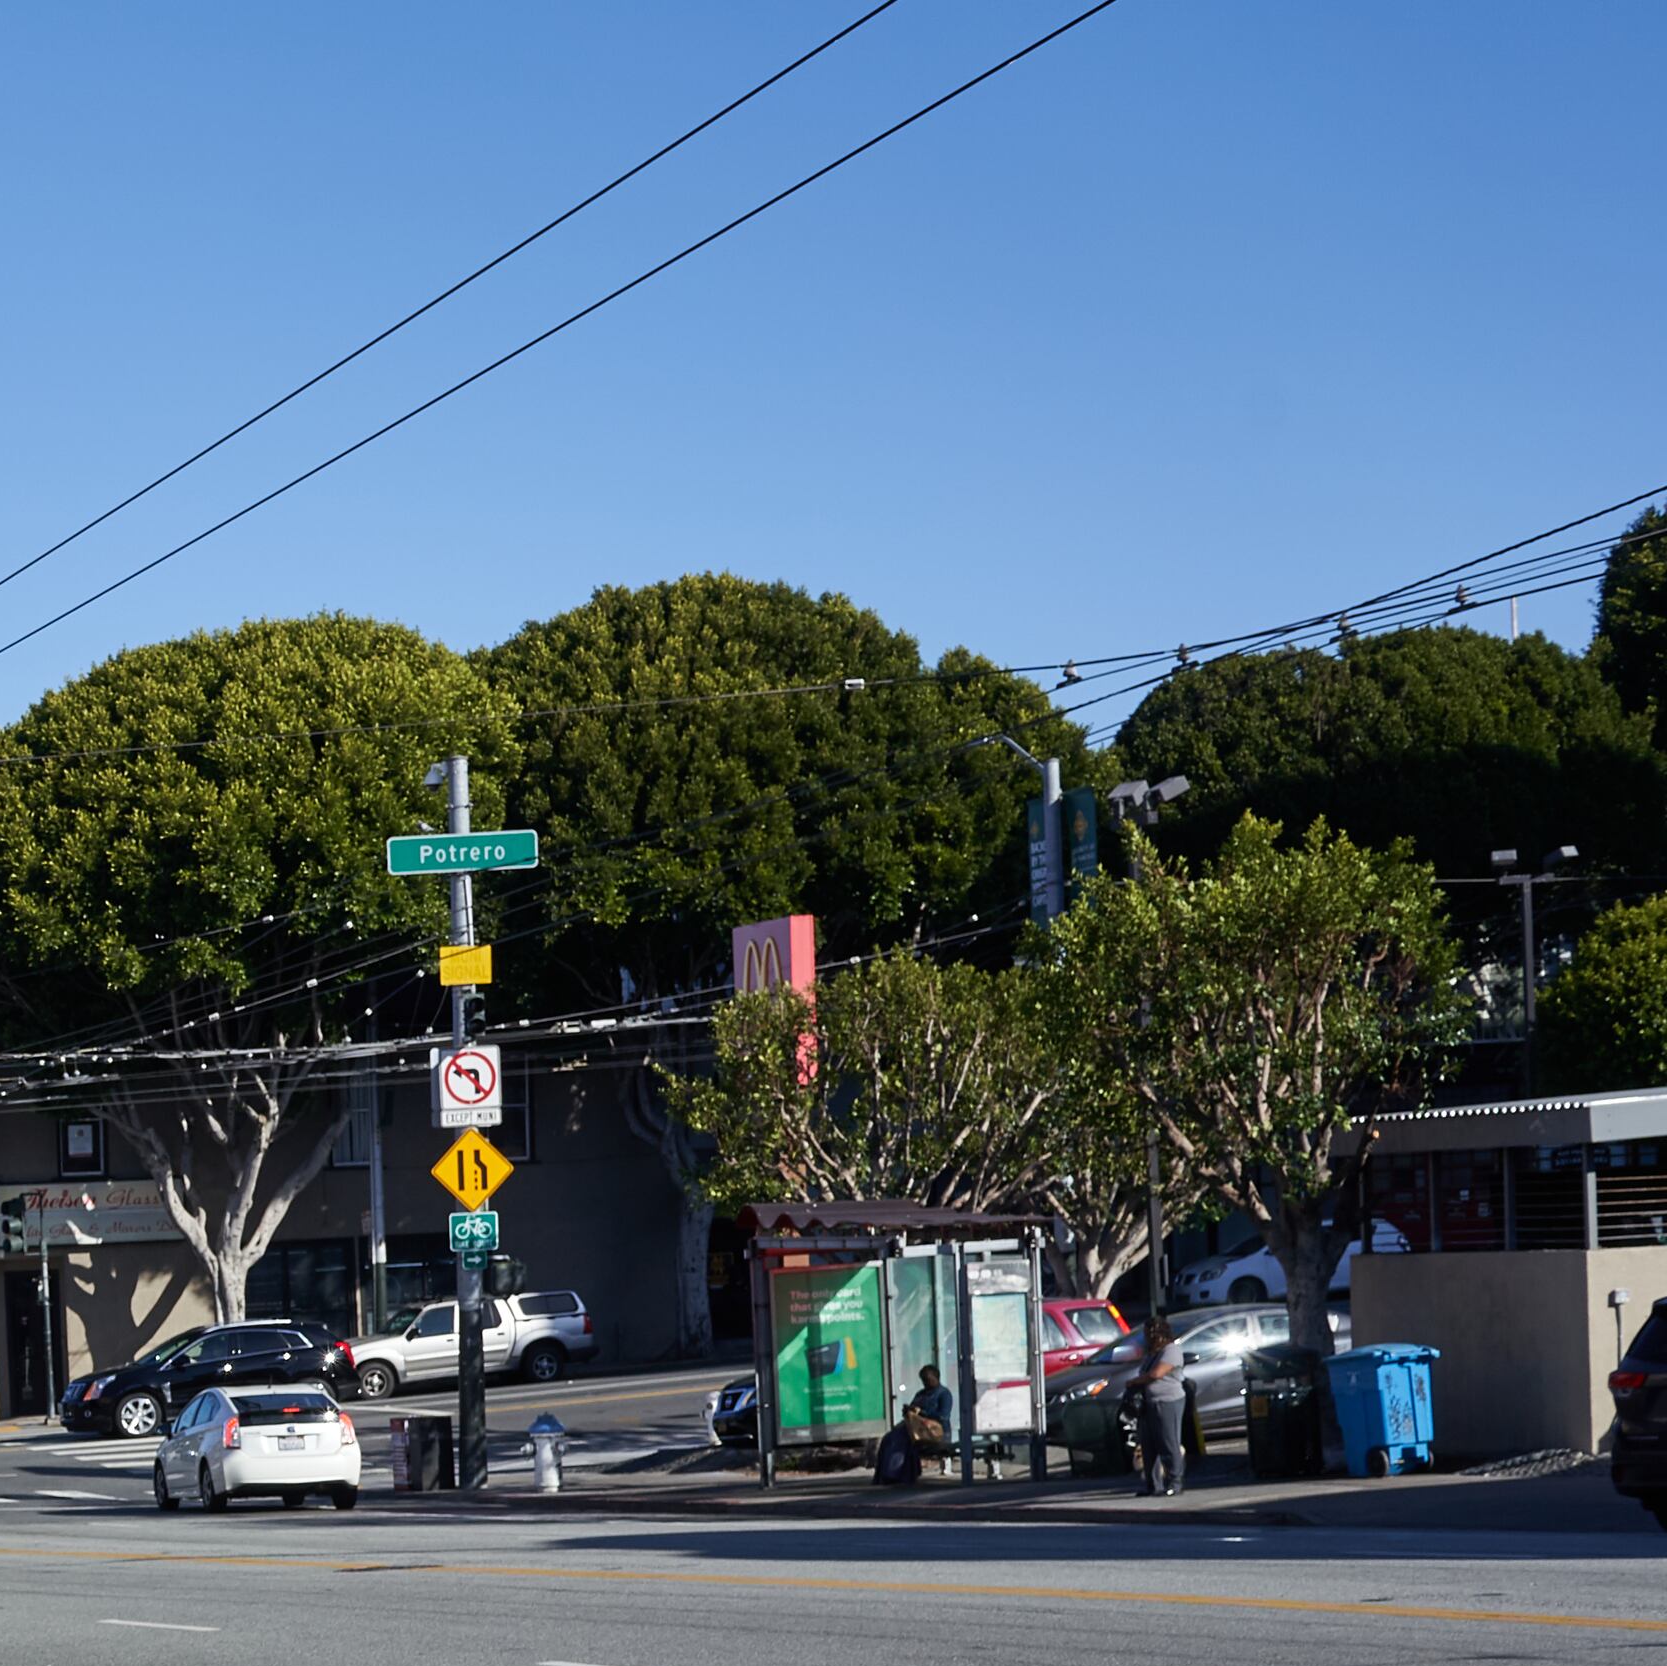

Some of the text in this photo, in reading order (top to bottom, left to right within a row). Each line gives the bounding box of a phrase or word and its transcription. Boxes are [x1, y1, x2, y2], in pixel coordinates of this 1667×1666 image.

[419, 844, 506, 864] Potrero
[444, 965, 489, 980] SIGNAL
[445, 1111, 498, 1124] EXCEPT MUNI
[107, 1188, 160, 1209] Glass
[790, 1290, 809, 1299] The
[836, 1286, 862, 1298] card
[790, 1302, 812, 1312] that
[843, 1302, 864, 1313] you
